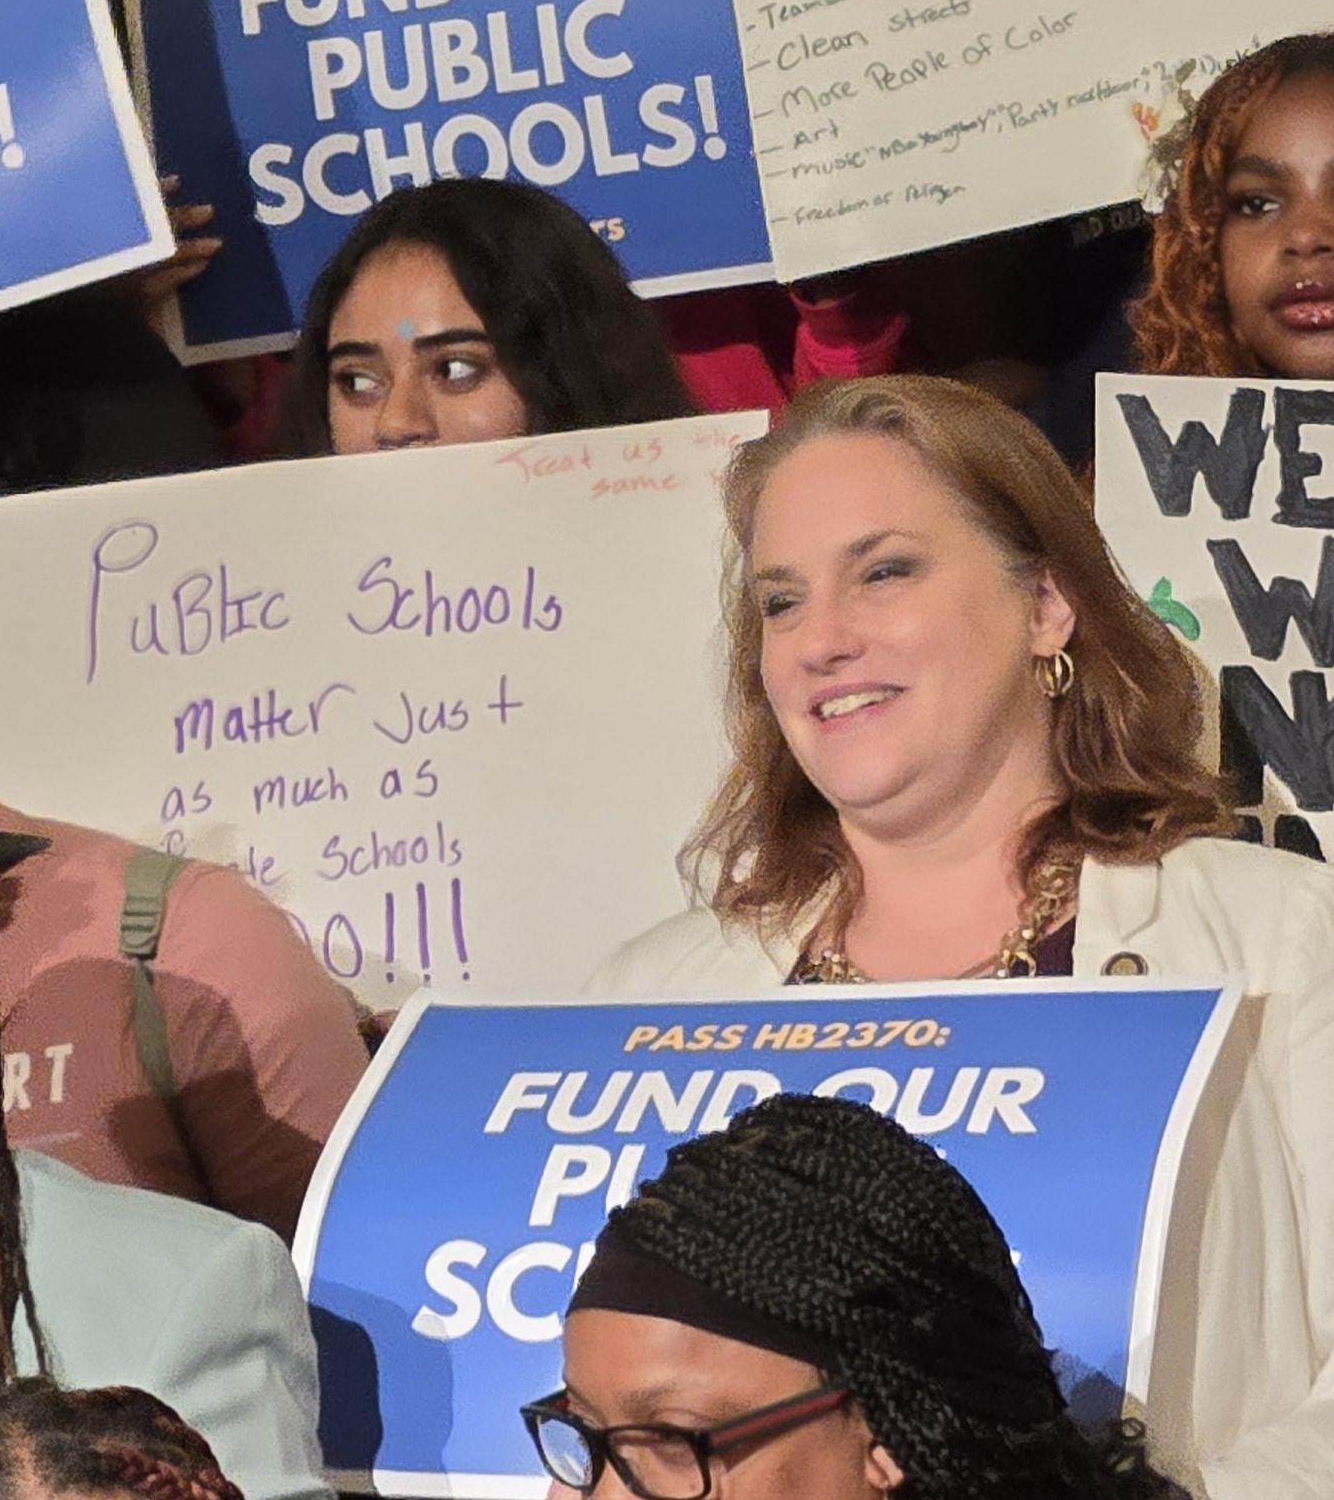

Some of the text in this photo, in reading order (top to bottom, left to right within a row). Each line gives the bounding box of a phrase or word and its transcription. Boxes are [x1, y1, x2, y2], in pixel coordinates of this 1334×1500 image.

[775, 30, 868, 72] Clean
[781, 78, 859, 122] More
[962, 32, 993, 66] of
[1004, 10, 1079, 53] Color
[347, 556, 563, 637] Schools
[159, 758, 440, 823] as much as
[621, 1018, 953, 1056] PASS HB2370:
